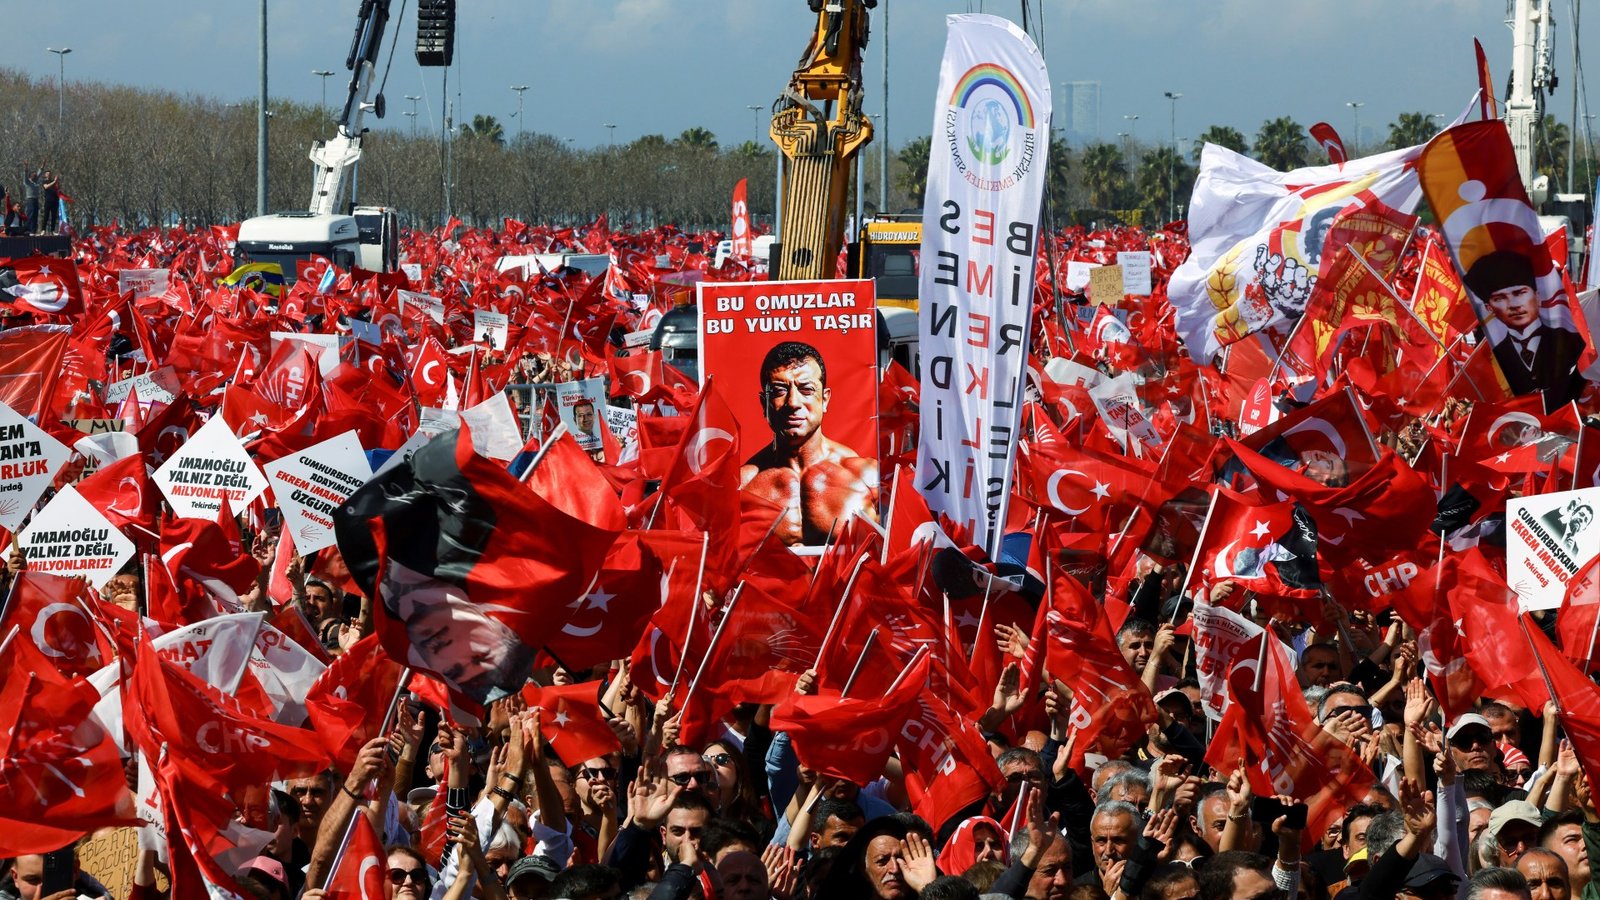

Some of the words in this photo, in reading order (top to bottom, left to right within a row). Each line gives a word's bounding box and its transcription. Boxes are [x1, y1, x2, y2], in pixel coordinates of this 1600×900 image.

[716, 296, 744, 312] BU
[755, 292, 856, 311] OMUZLAR
[706, 318, 734, 334] BU
[745, 309, 802, 333] YÜKÜ
[812, 313, 873, 334] TAŞIR
[178, 456, 246, 473] İMAMOĞLU
[169, 470, 212, 485] YALNIZ
[213, 473, 252, 490] DEĞİL,
[276, 470, 311, 491] EKREM
[310, 473, 355, 497] ADAYIMIZ
[171, 485, 246, 501] MİLYONLARIZ!
[191, 501, 221, 513] Tekirdağ
[300, 509, 335, 530] Tekirdağ
[31, 528, 109, 544] İMAMOĞLU
[1510, 518, 1540, 551] EKREM
[21, 545, 71, 559] YALNIZ
[74, 542, 119, 557] DEĞİL,
[27, 558, 113, 571] MİLYONLARIZ!
[1523, 557, 1549, 588] Tekirdağ
[1364, 562, 1418, 597] CHP
[196, 720, 271, 754] CHP
[901, 719, 957, 776] CHP
